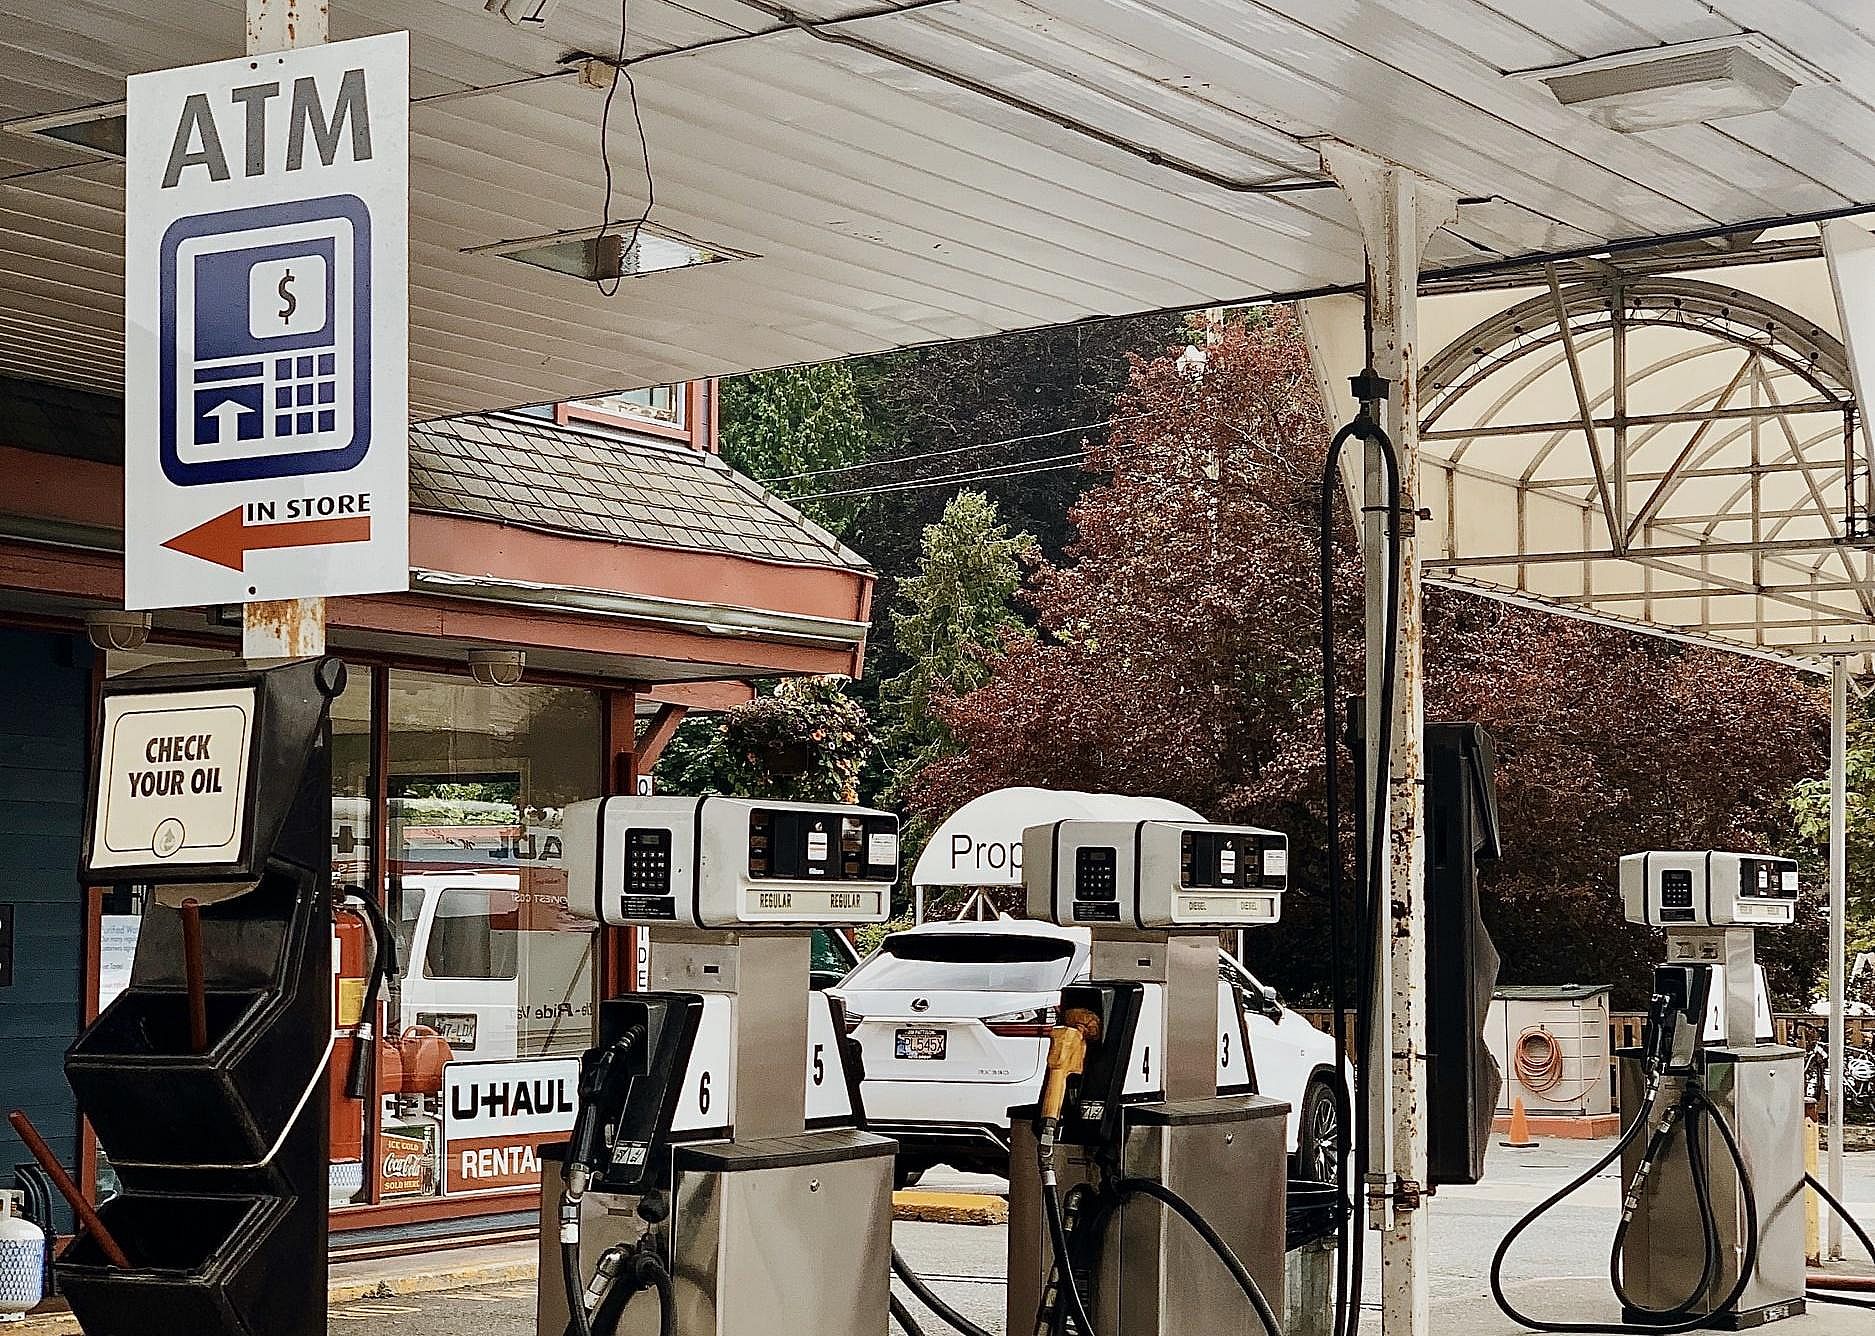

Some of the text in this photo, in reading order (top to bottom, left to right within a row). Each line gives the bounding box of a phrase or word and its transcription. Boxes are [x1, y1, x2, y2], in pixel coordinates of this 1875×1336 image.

[161, 69, 373, 188] ATM
[247, 493, 371, 522] IN STORE
[145, 734, 213, 764] CHECK
[128, 767, 223, 798] YOUR OIL
[760, 893, 861, 909] REGULAR REGULAR
[1713, 1005, 1719, 1031] 2
[813, 1043, 824, 1086] 5
[1142, 1046, 1150, 1083] 4
[1221, 1032, 1230, 1068] 3
[699, 1071, 711, 1116] 6
[384, 1181, 403, 1190] SOLD
